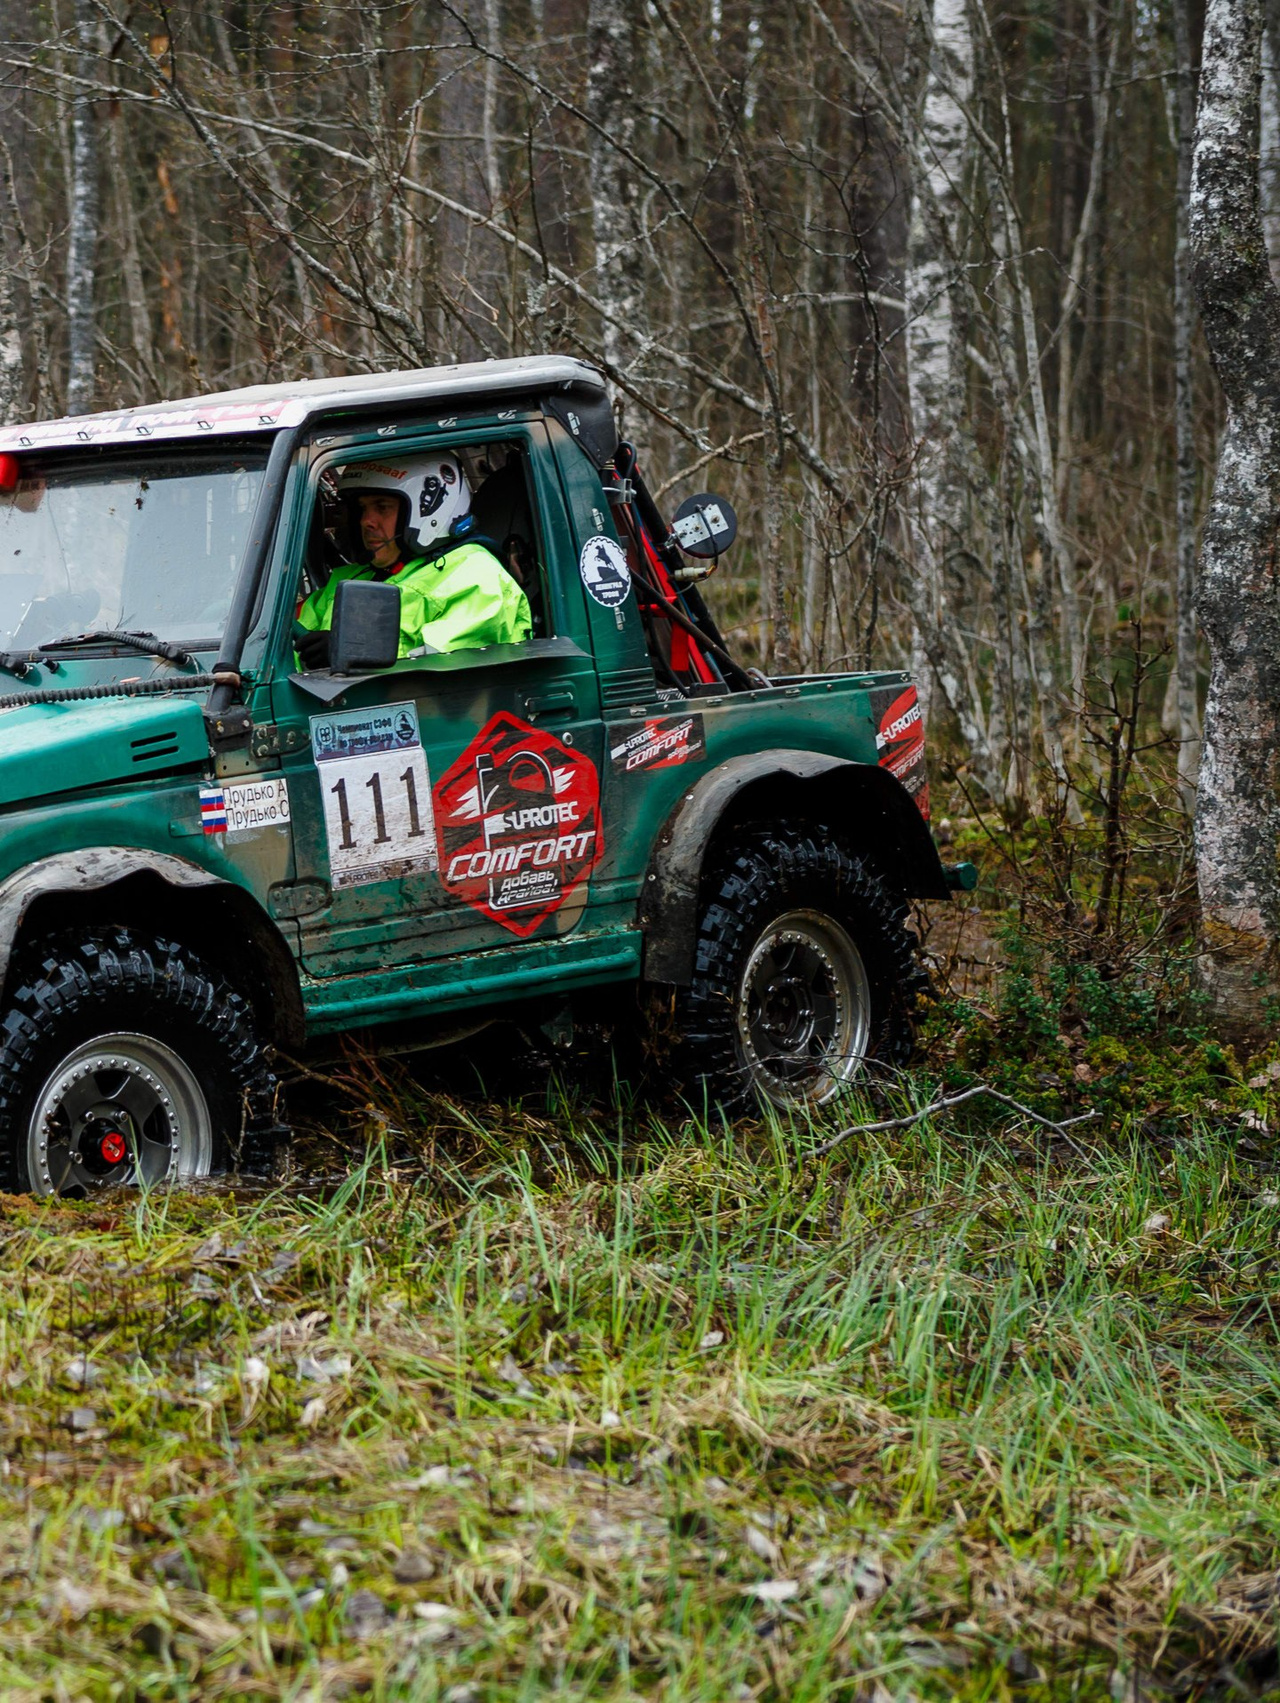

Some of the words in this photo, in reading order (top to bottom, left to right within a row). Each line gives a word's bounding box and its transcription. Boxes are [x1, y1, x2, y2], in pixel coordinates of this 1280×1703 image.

[625, 725, 694, 770] COMFORT
[626, 727, 657, 749] SUPROTEC
[223, 785, 274, 808] Прудько
[331, 767, 425, 850] 111
[225, 806, 277, 828] Прудько
[280, 799, 289, 818] С
[505, 801, 579, 830] SUPROTEC
[446, 830, 596, 882] COMFORT
[497, 879, 558, 905] драйва!
[500, 871, 555, 892] добавь
